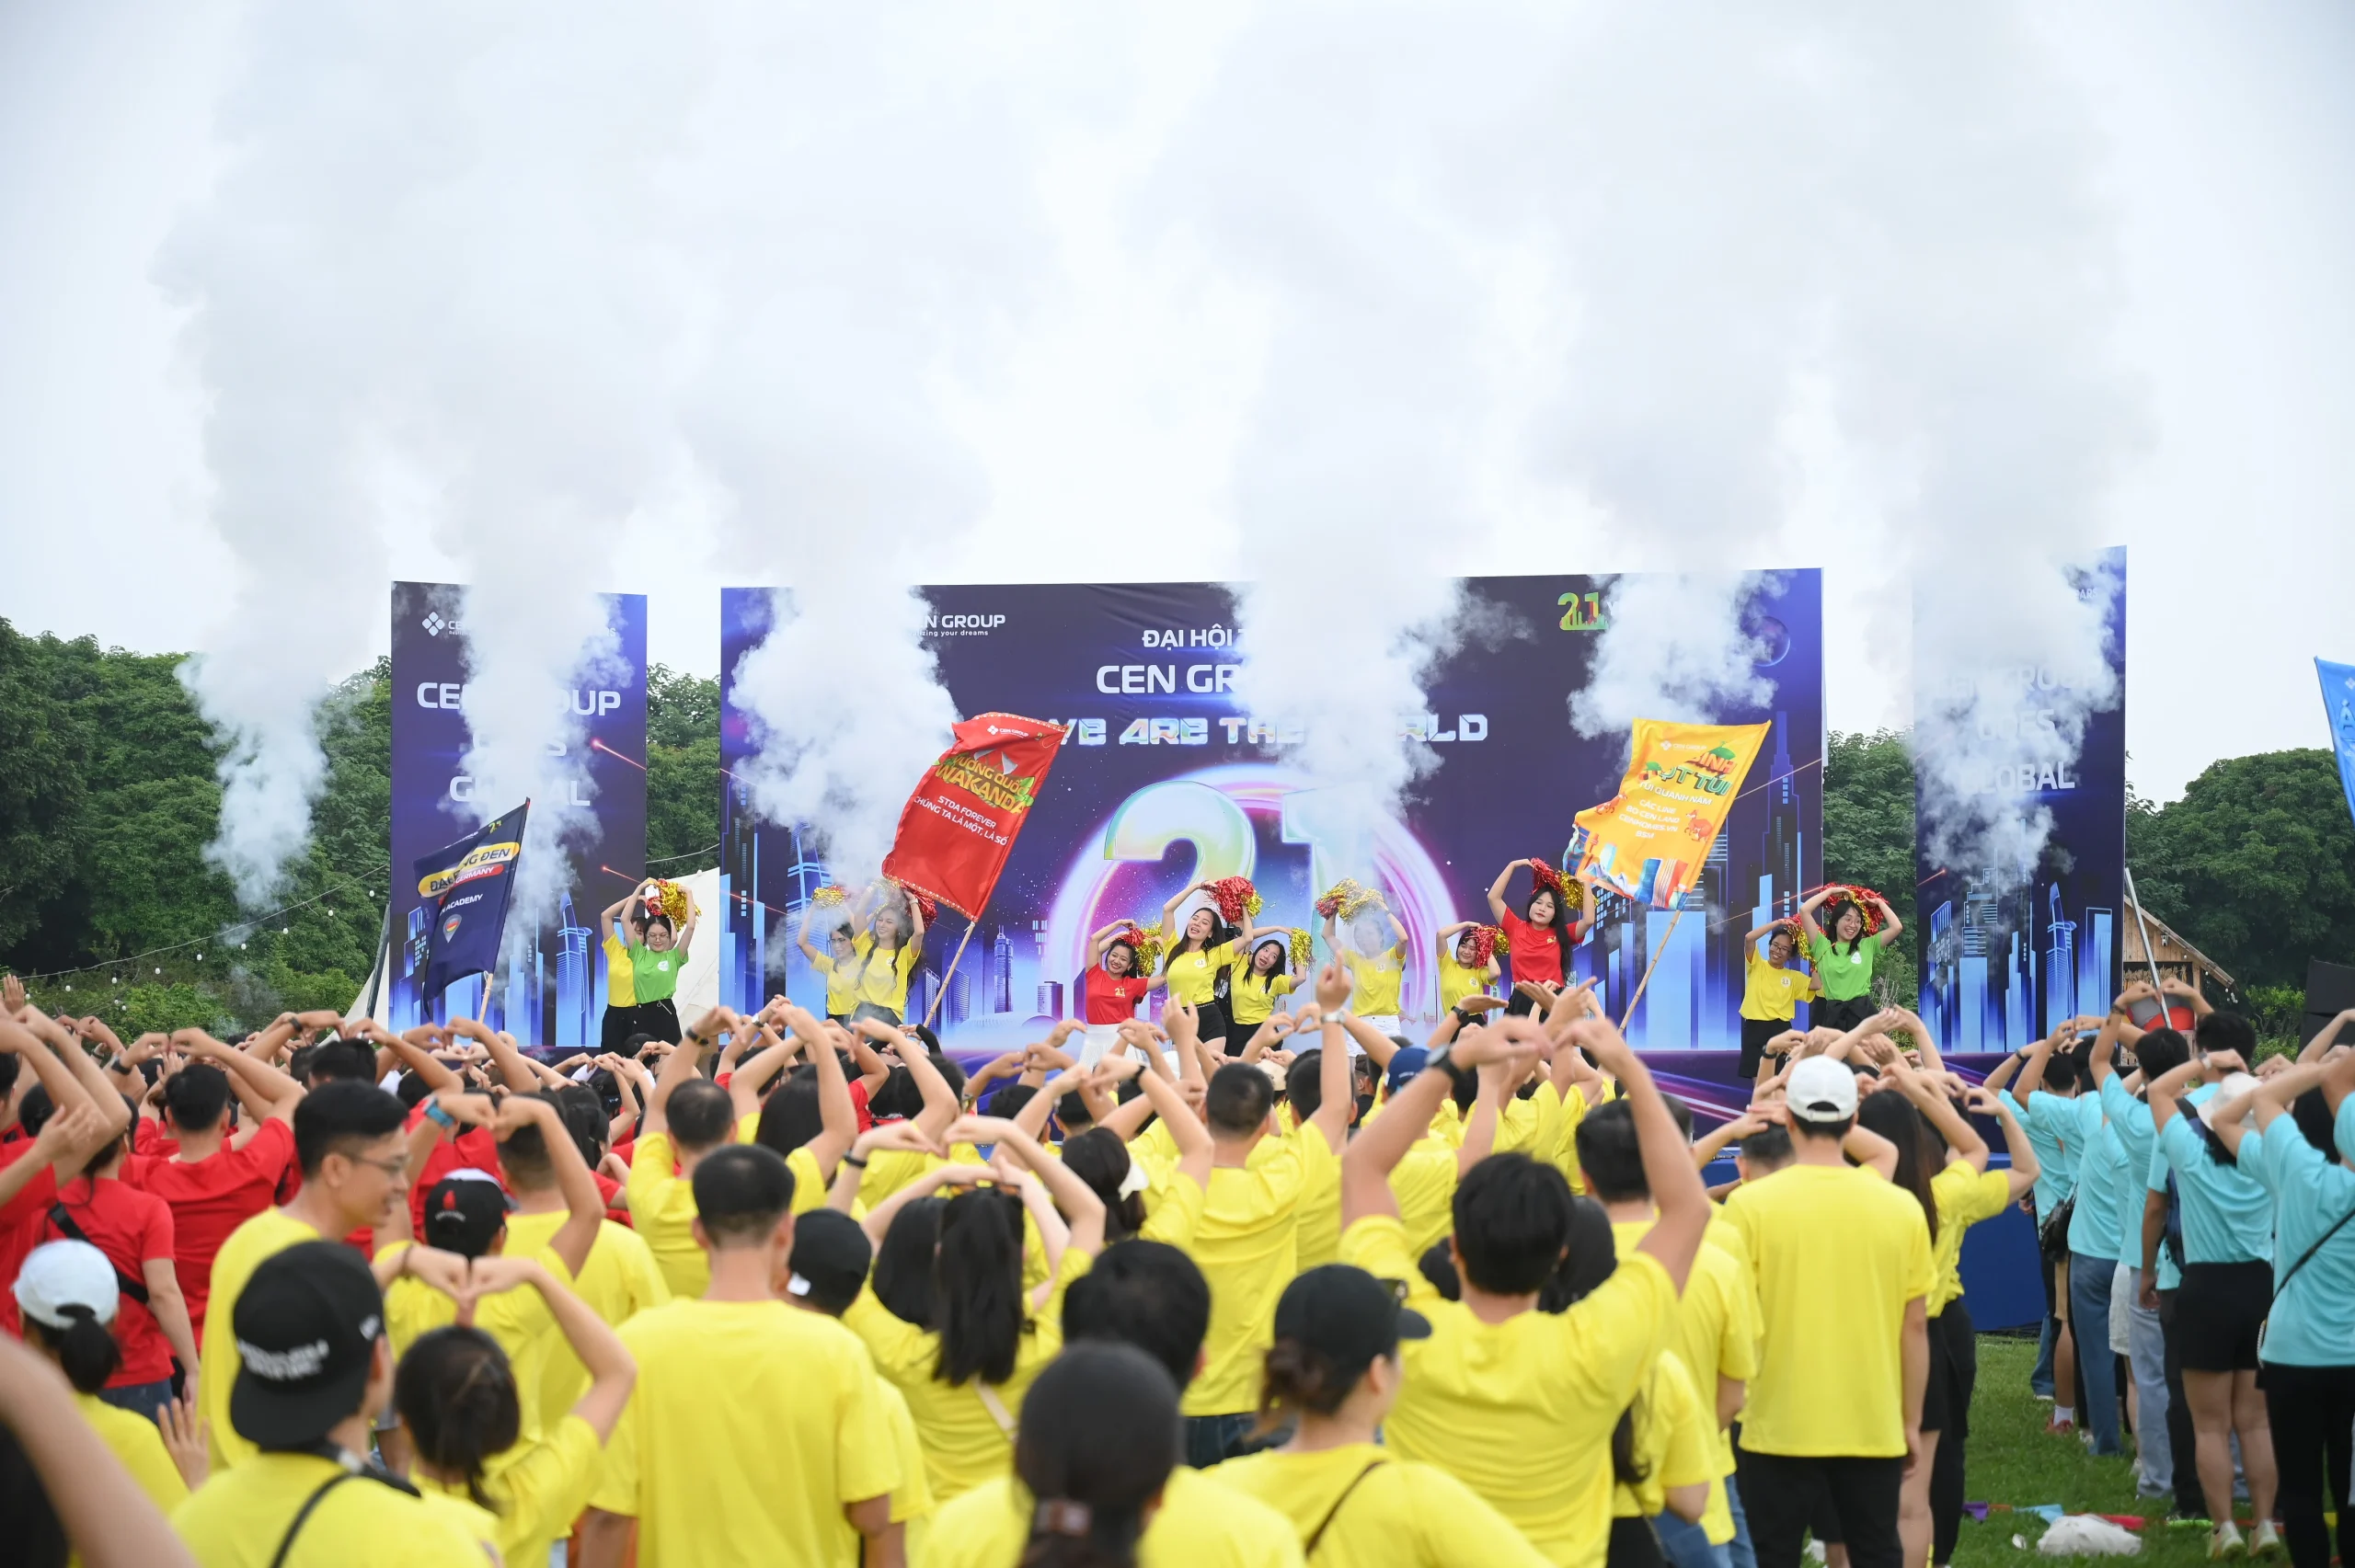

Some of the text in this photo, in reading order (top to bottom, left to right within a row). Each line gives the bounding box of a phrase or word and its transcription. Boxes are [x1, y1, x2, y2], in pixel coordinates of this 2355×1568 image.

[941, 614, 1005, 628] GROUP
[1557, 591, 1609, 631] 21
[1142, 629, 1184, 651] ĐẠI
[1189, 623, 1233, 651] HỘI
[1096, 663, 1176, 694] CEN
[1119, 717, 1209, 746] ARE
[1218, 716, 1305, 745] THE
[935, 763, 1027, 814] WAKANDA
[1655, 786, 1690, 802] QUANH
[937, 795, 997, 830] STDA FOREVER
[941, 808, 952, 820] TA
[480, 848, 511, 862] ĐEN
[455, 866, 494, 883] GERMANY
[444, 893, 484, 910] ACADEMY
